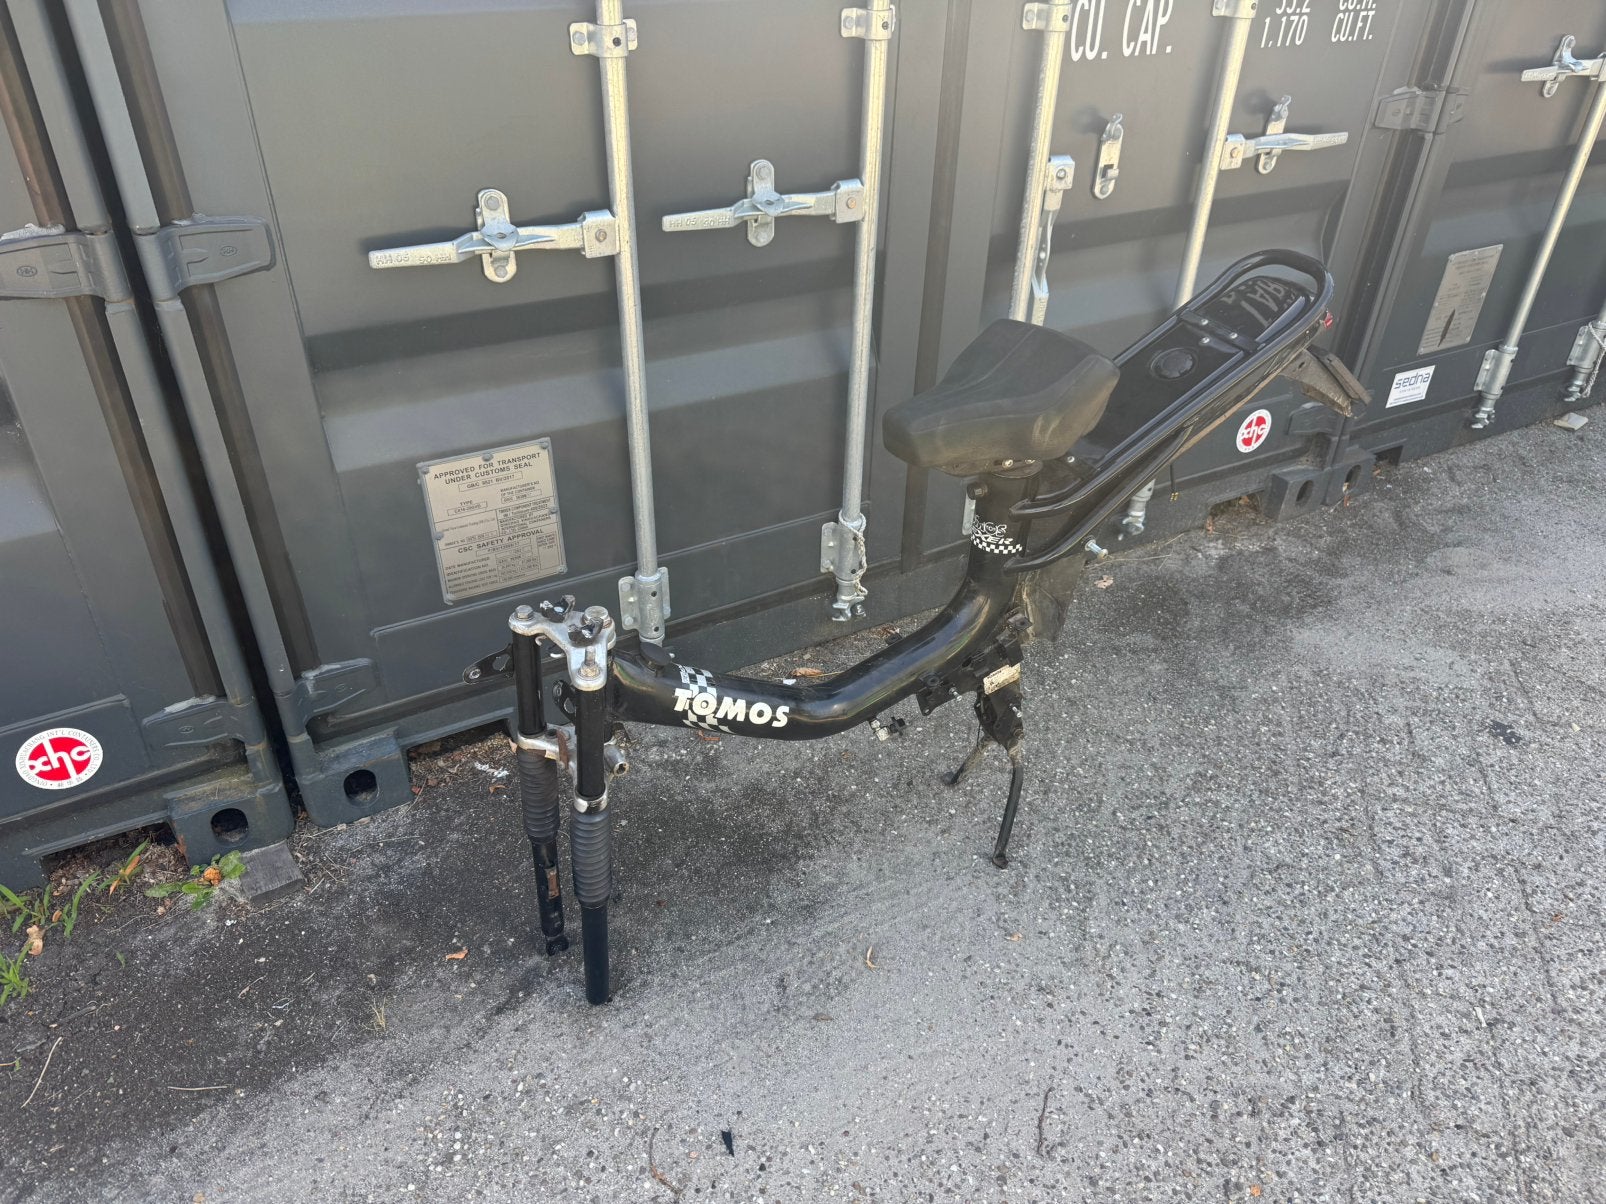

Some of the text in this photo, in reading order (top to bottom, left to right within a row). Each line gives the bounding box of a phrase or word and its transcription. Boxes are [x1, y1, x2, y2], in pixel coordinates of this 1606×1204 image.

[1070, 0, 1174, 62] CU. CAP.
[1331, 11, 1375, 43] CU.FT.
[1394, 371, 1432, 390] sedna
[433, 451, 540, 480] APPROVED FOR TRANSPORT
[444, 460, 532, 484] UNDER CUSTOMS SEAL
[457, 545, 473, 554] CSC
[475, 537, 504, 549] SAFETY
[506, 527, 543, 542] APPROVAL
[674, 687, 790, 728] TOMOS
